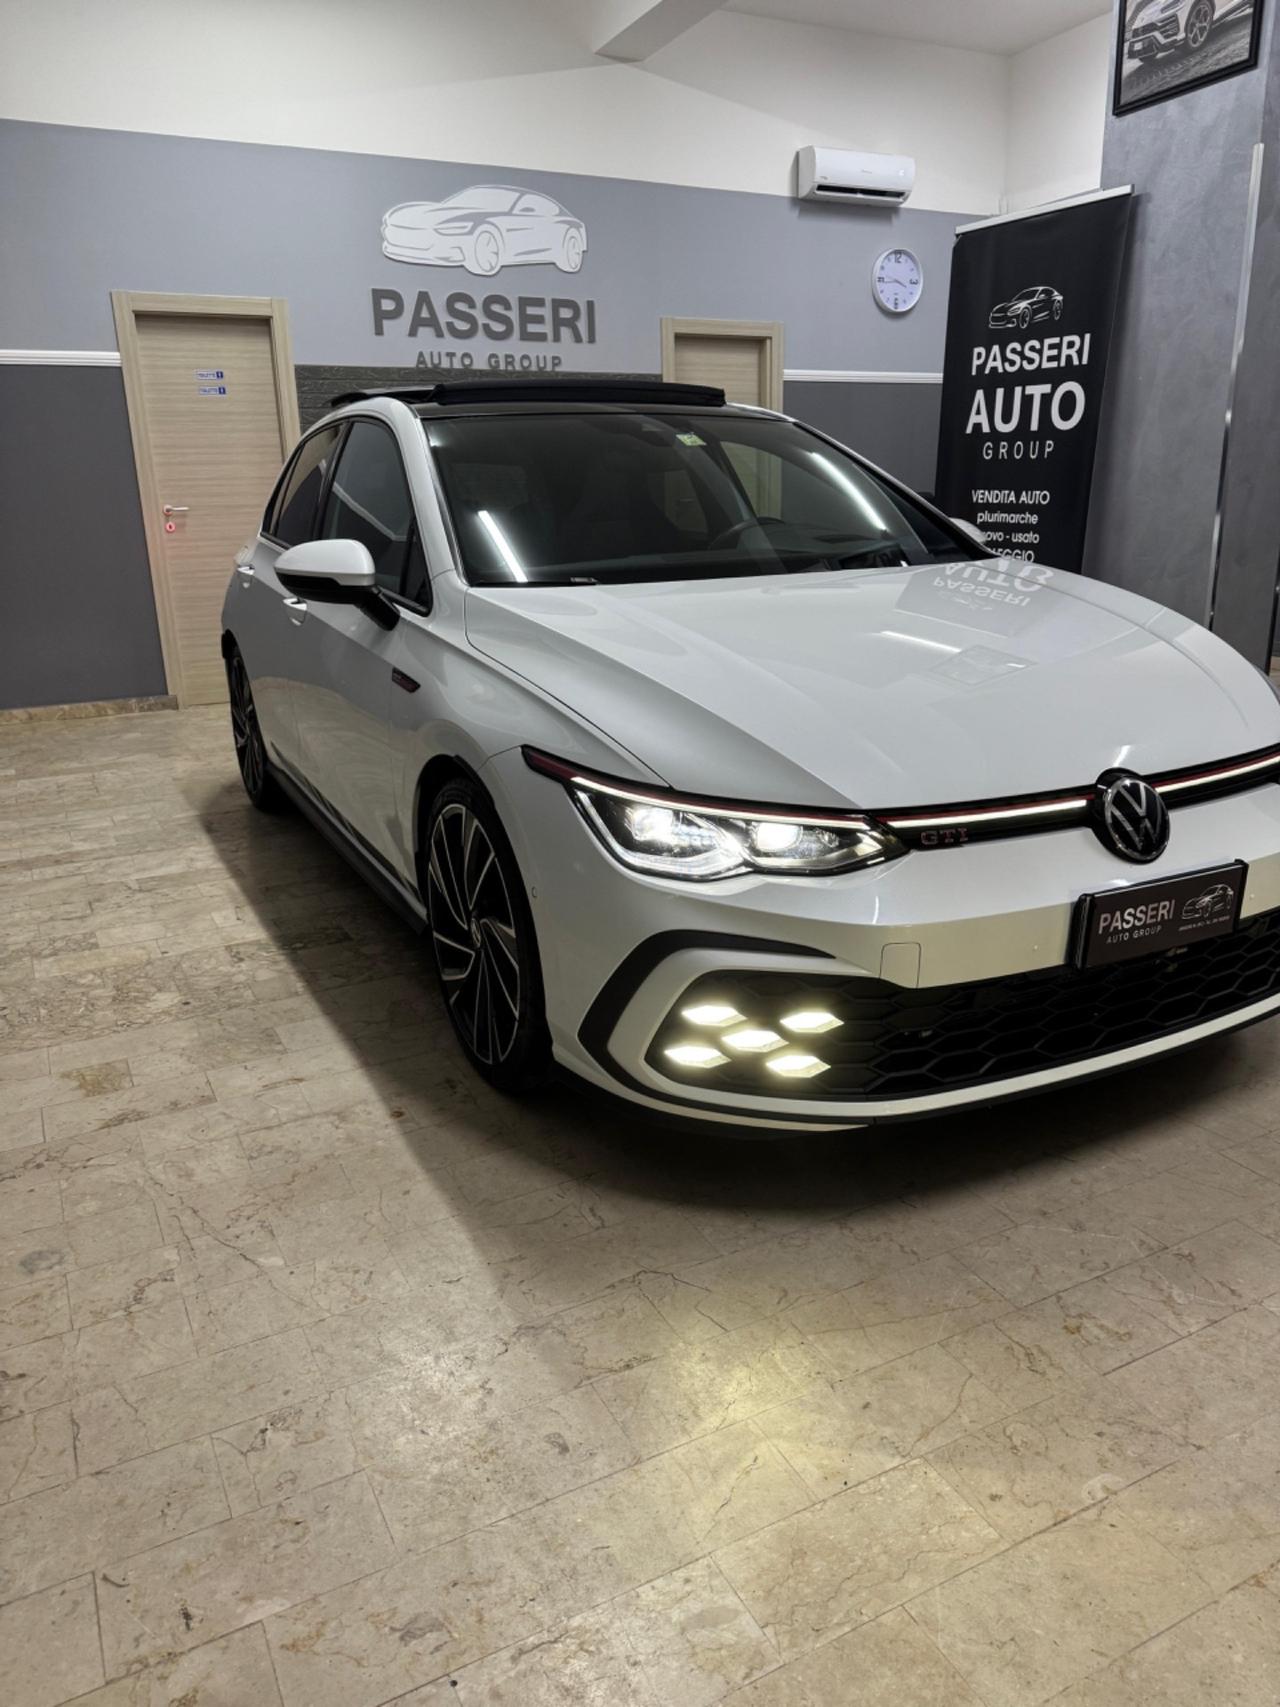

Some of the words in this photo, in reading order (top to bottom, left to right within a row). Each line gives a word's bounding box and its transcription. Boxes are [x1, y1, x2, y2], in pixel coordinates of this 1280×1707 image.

[371, 287, 597, 344] PASSERI
[415, 351, 474, 370] AUTO
[487, 352, 563, 372] GROUP
[971, 333, 1091, 376] PASSERI
[965, 381, 1086, 434] AUTO
[982, 440, 1054, 460] GROUP
[971, 489, 1017, 504] VENDITA
[1018, 490, 1050, 505] AUTO
[976, 510, 1038, 525] plurimarche
[1011, 530, 1040, 544] usato
[921, 827, 969, 845] GTI
[1098, 900, 1176, 935] PASSERI
[1106, 932, 1130, 944] AUTO
[1133, 925, 1162, 938] GROUP
